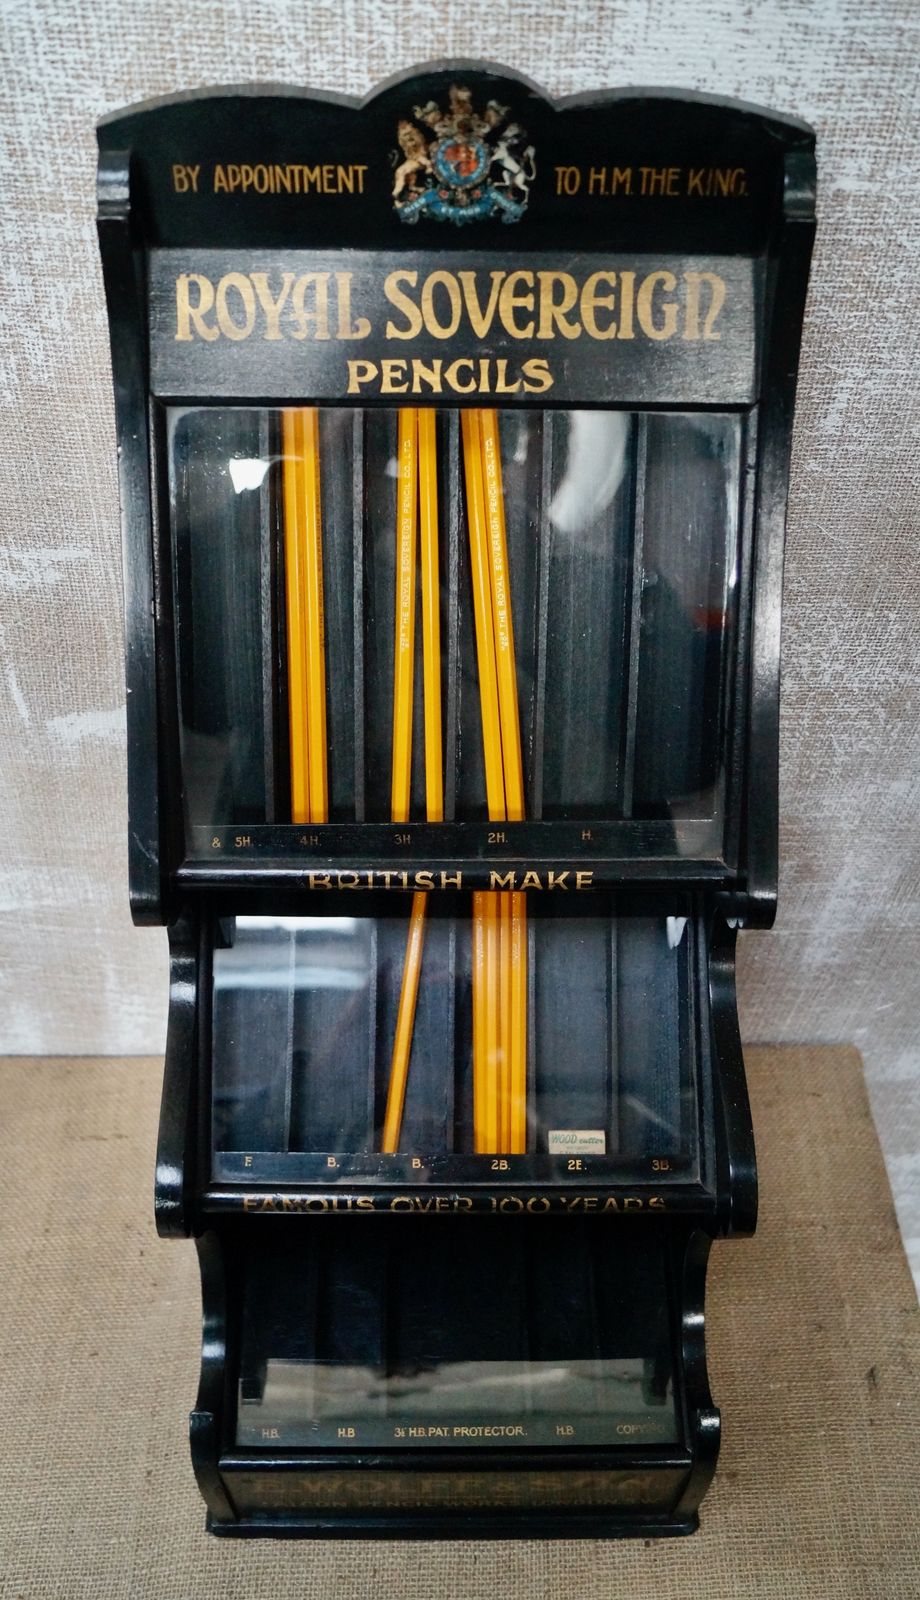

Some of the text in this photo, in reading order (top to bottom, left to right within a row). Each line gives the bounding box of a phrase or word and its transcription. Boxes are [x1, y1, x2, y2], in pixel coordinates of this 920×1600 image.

[172, 164, 200, 193] BY
[213, 164, 369, 194] APPOINTMENT
[554, 166, 582, 196] TO
[639, 167, 681, 196] THE
[174, 270, 727, 342] ROYAL SOVEREIGN
[347, 358, 554, 394] PENCILS
[307, 869, 594, 891] BRITISH MAKE
[551, 1134, 577, 1145] WOOD
[390, 1196, 474, 1212] OVER
[489, 1196, 551, 1213] 100
[453, 1425, 528, 1437] PROTECTOR.
